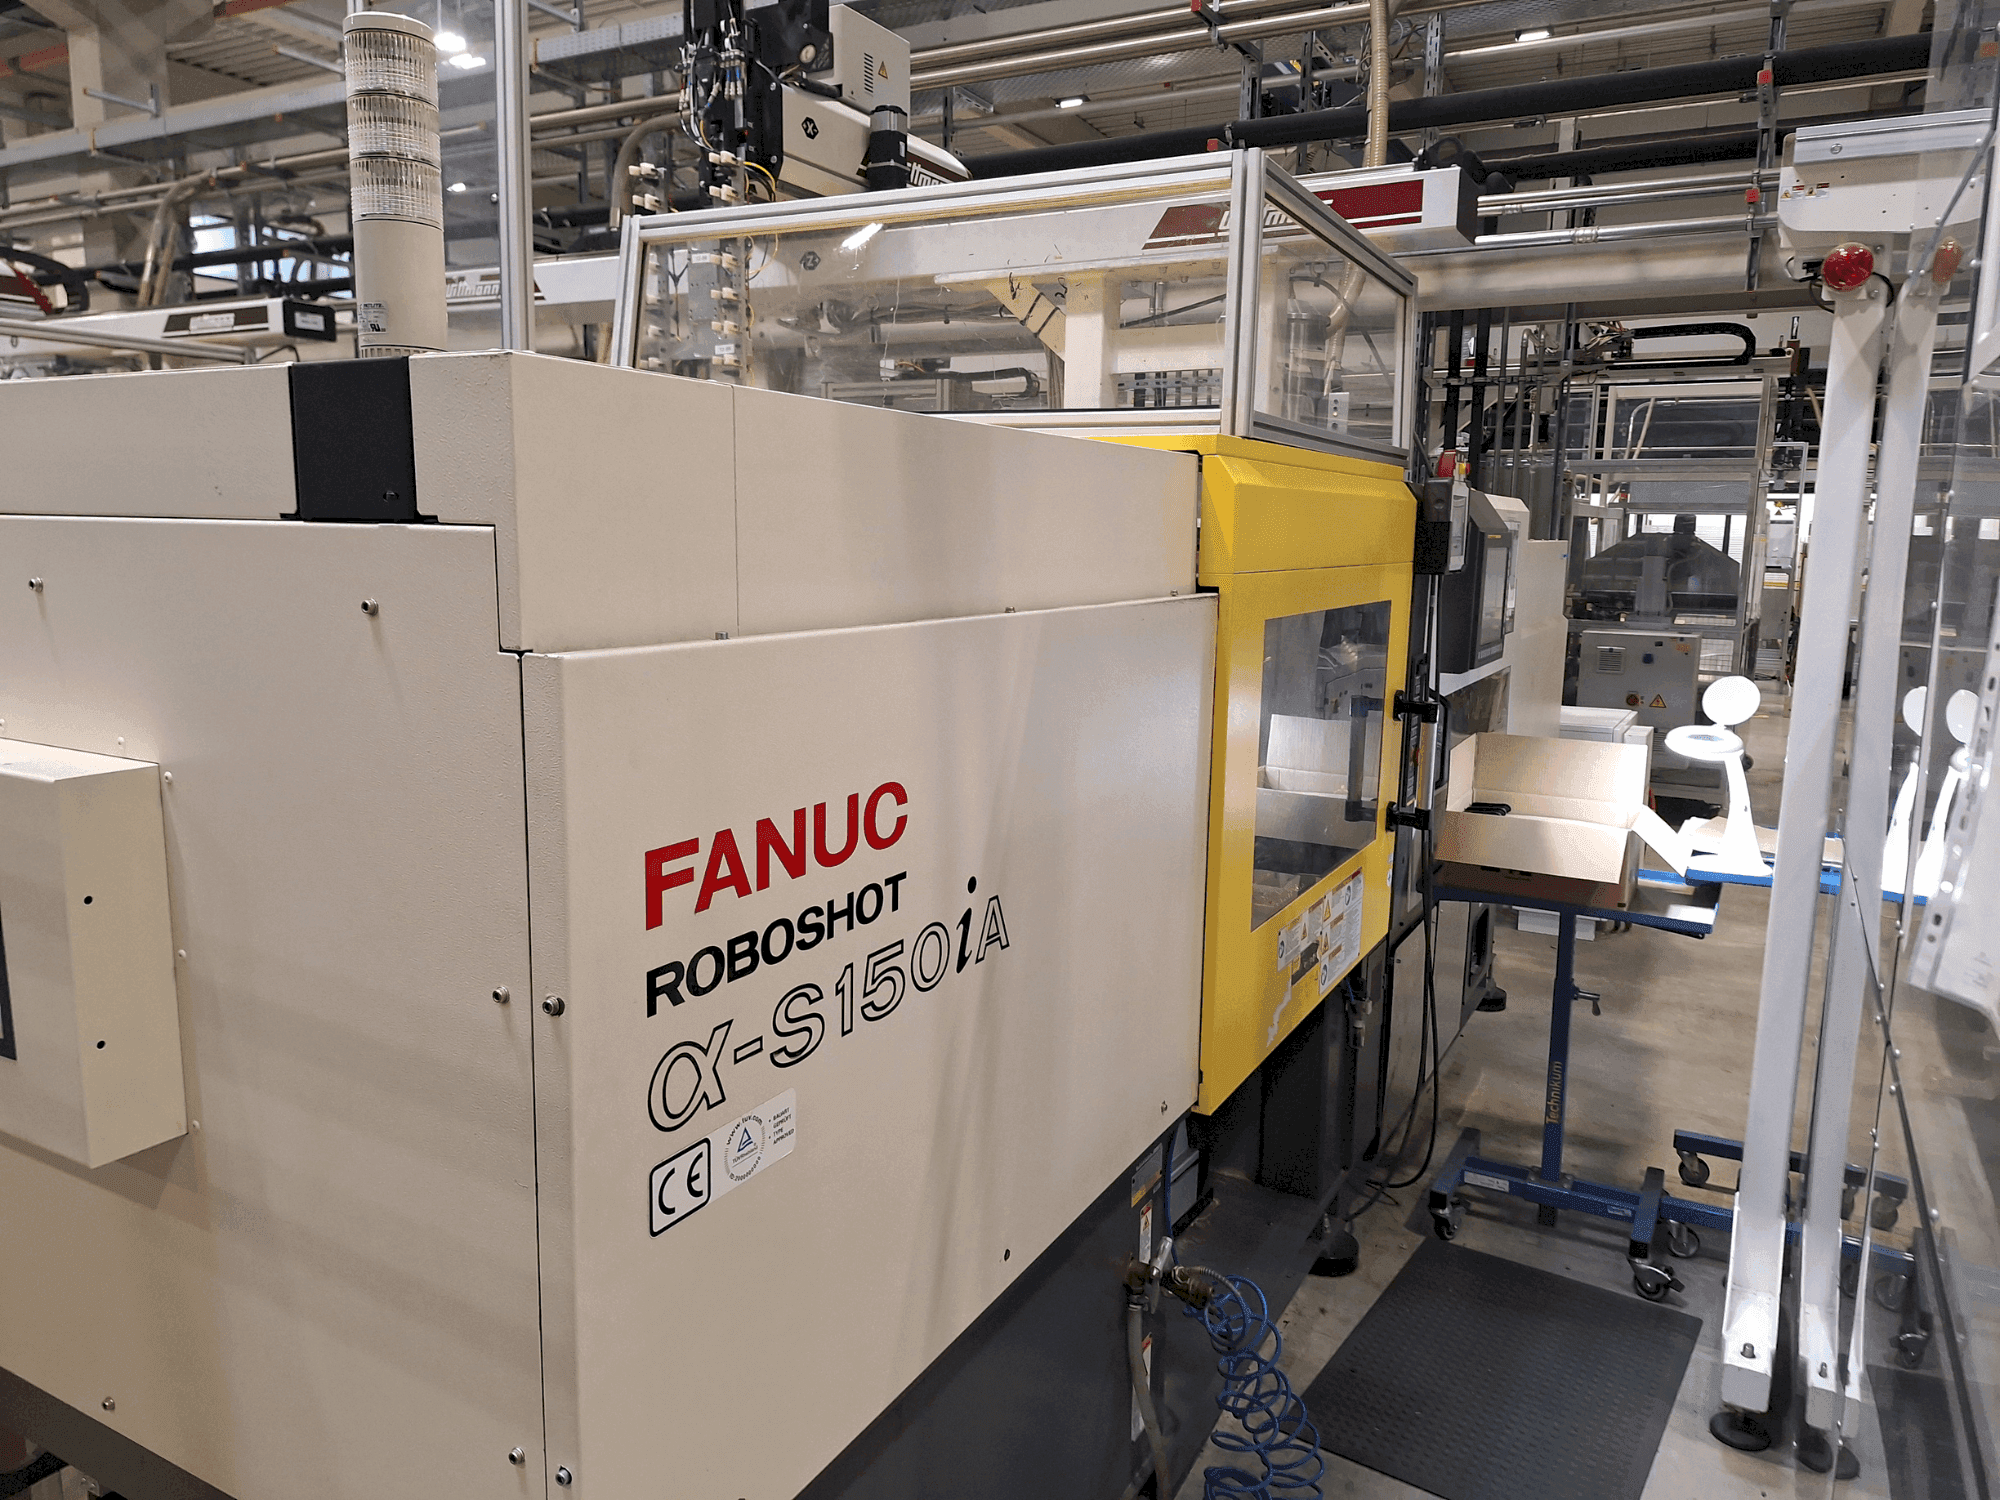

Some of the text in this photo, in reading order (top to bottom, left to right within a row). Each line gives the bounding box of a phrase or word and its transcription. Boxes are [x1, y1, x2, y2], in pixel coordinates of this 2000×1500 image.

[645, 781, 908, 931] FANUC
[646, 872, 907, 1018] ROBOSHOT
[1545, 1061, 1563, 1124] Technikum
[658, 1151, 703, 1215] CE
